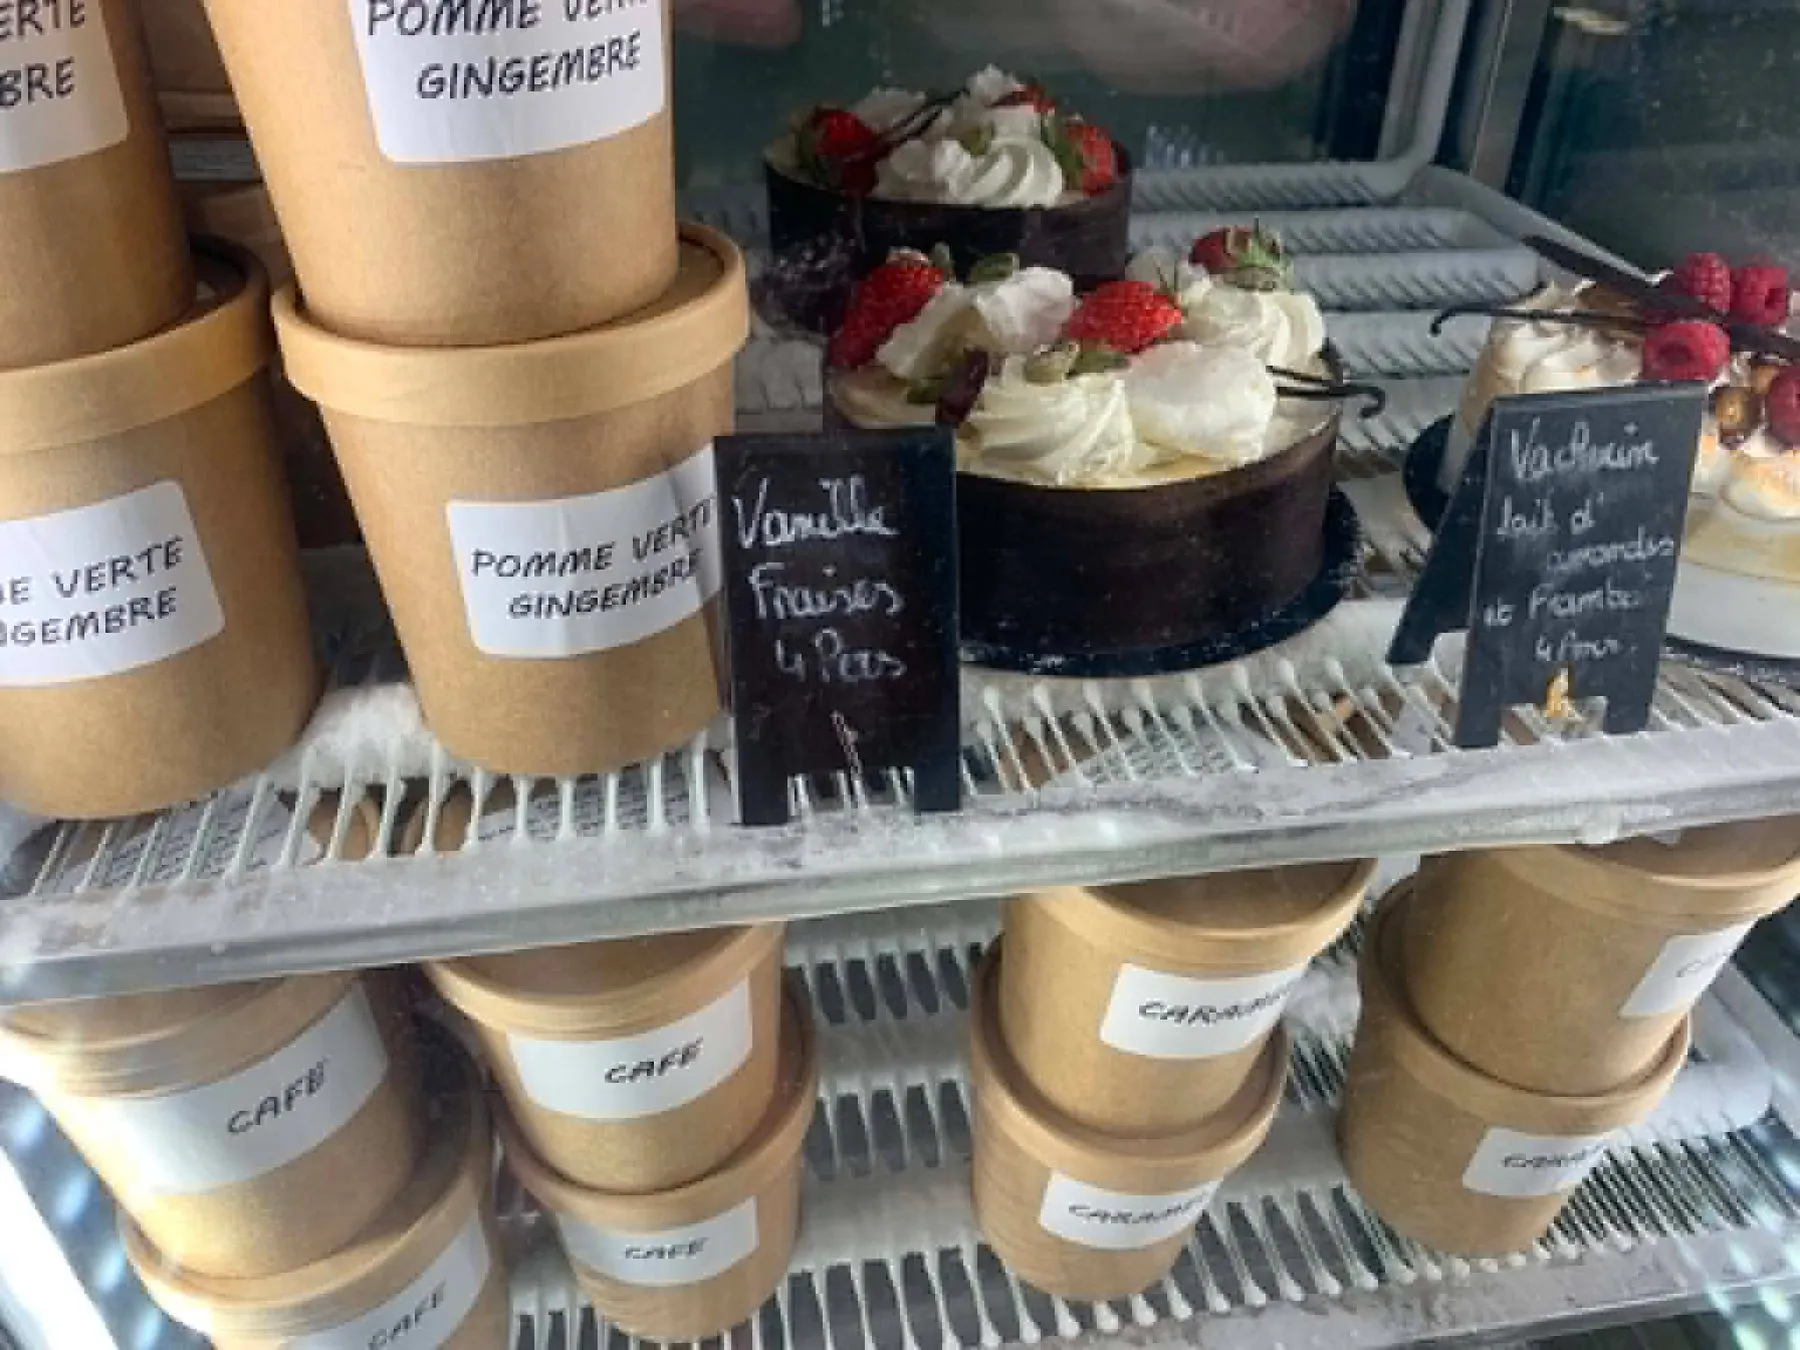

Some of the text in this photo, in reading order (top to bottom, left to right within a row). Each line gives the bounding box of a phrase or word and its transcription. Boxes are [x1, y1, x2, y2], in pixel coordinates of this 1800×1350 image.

[367, 0, 541, 35] POMME
[416, 31, 641, 99] GINGEMBRE
[731, 477, 900, 549] Vanille
[0, 535, 183, 605] E VERTE
[471, 540, 616, 577] POMME
[507, 548, 704, 618] GINGEMBRE
[748, 562, 904, 619] Fraises
[775, 637, 805, 681] 4
